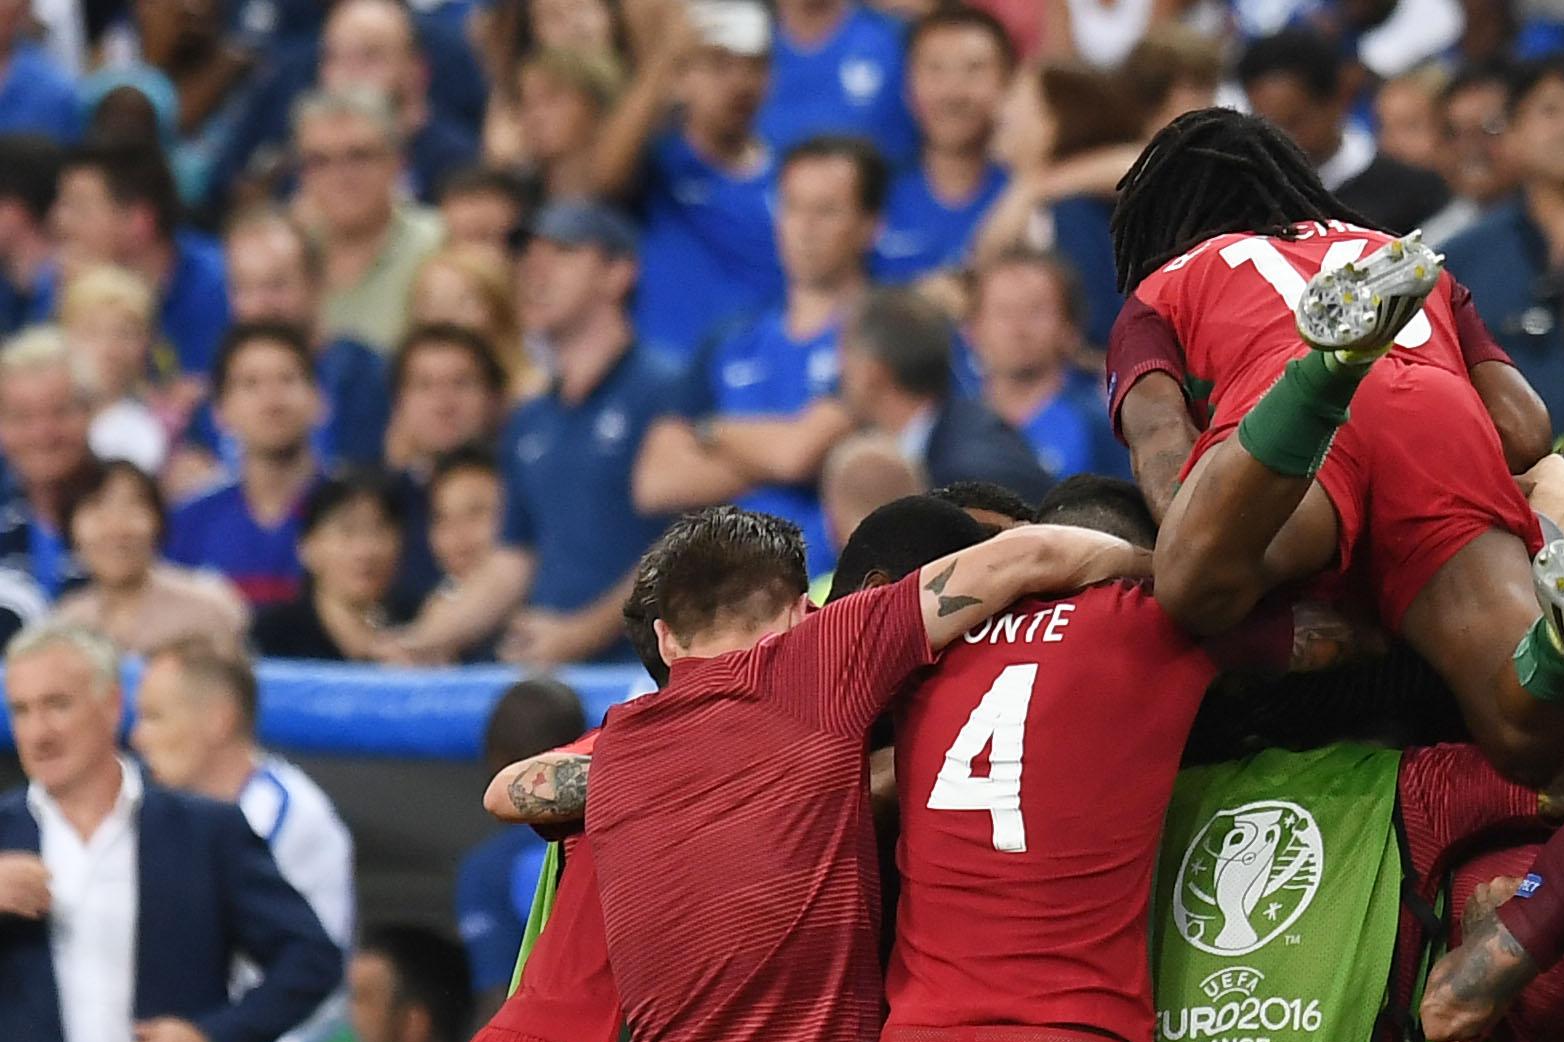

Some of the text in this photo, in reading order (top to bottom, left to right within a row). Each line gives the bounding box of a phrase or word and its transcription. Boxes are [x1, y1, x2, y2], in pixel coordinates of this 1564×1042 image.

[963, 603, 1076, 645] ONTE
[926, 663, 1039, 853] 4
[1203, 972, 1259, 998] UEFA
[1157, 997, 1322, 1041] URO2016
